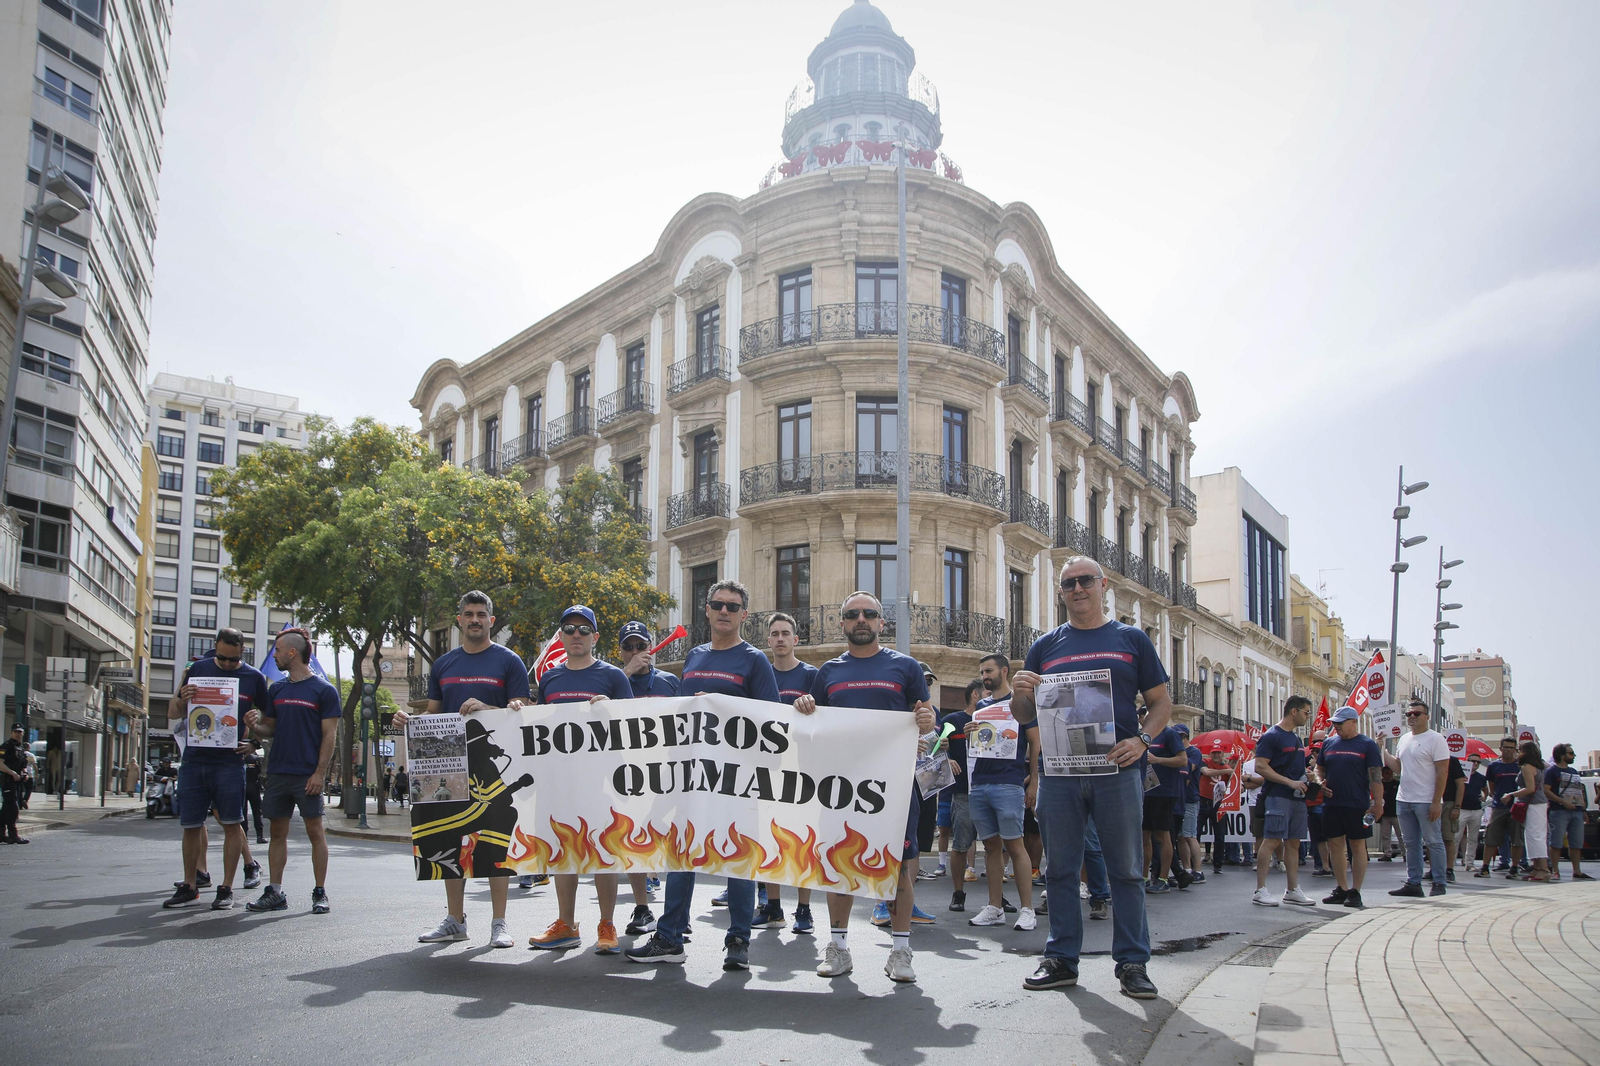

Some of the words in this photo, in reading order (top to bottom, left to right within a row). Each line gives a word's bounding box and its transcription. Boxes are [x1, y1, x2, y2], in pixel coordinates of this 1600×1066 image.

[1070, 672, 1107, 682] BOMBEROS
[520, 711, 789, 756] BOMBEROS
[612, 758, 887, 814] QUEMADOS
